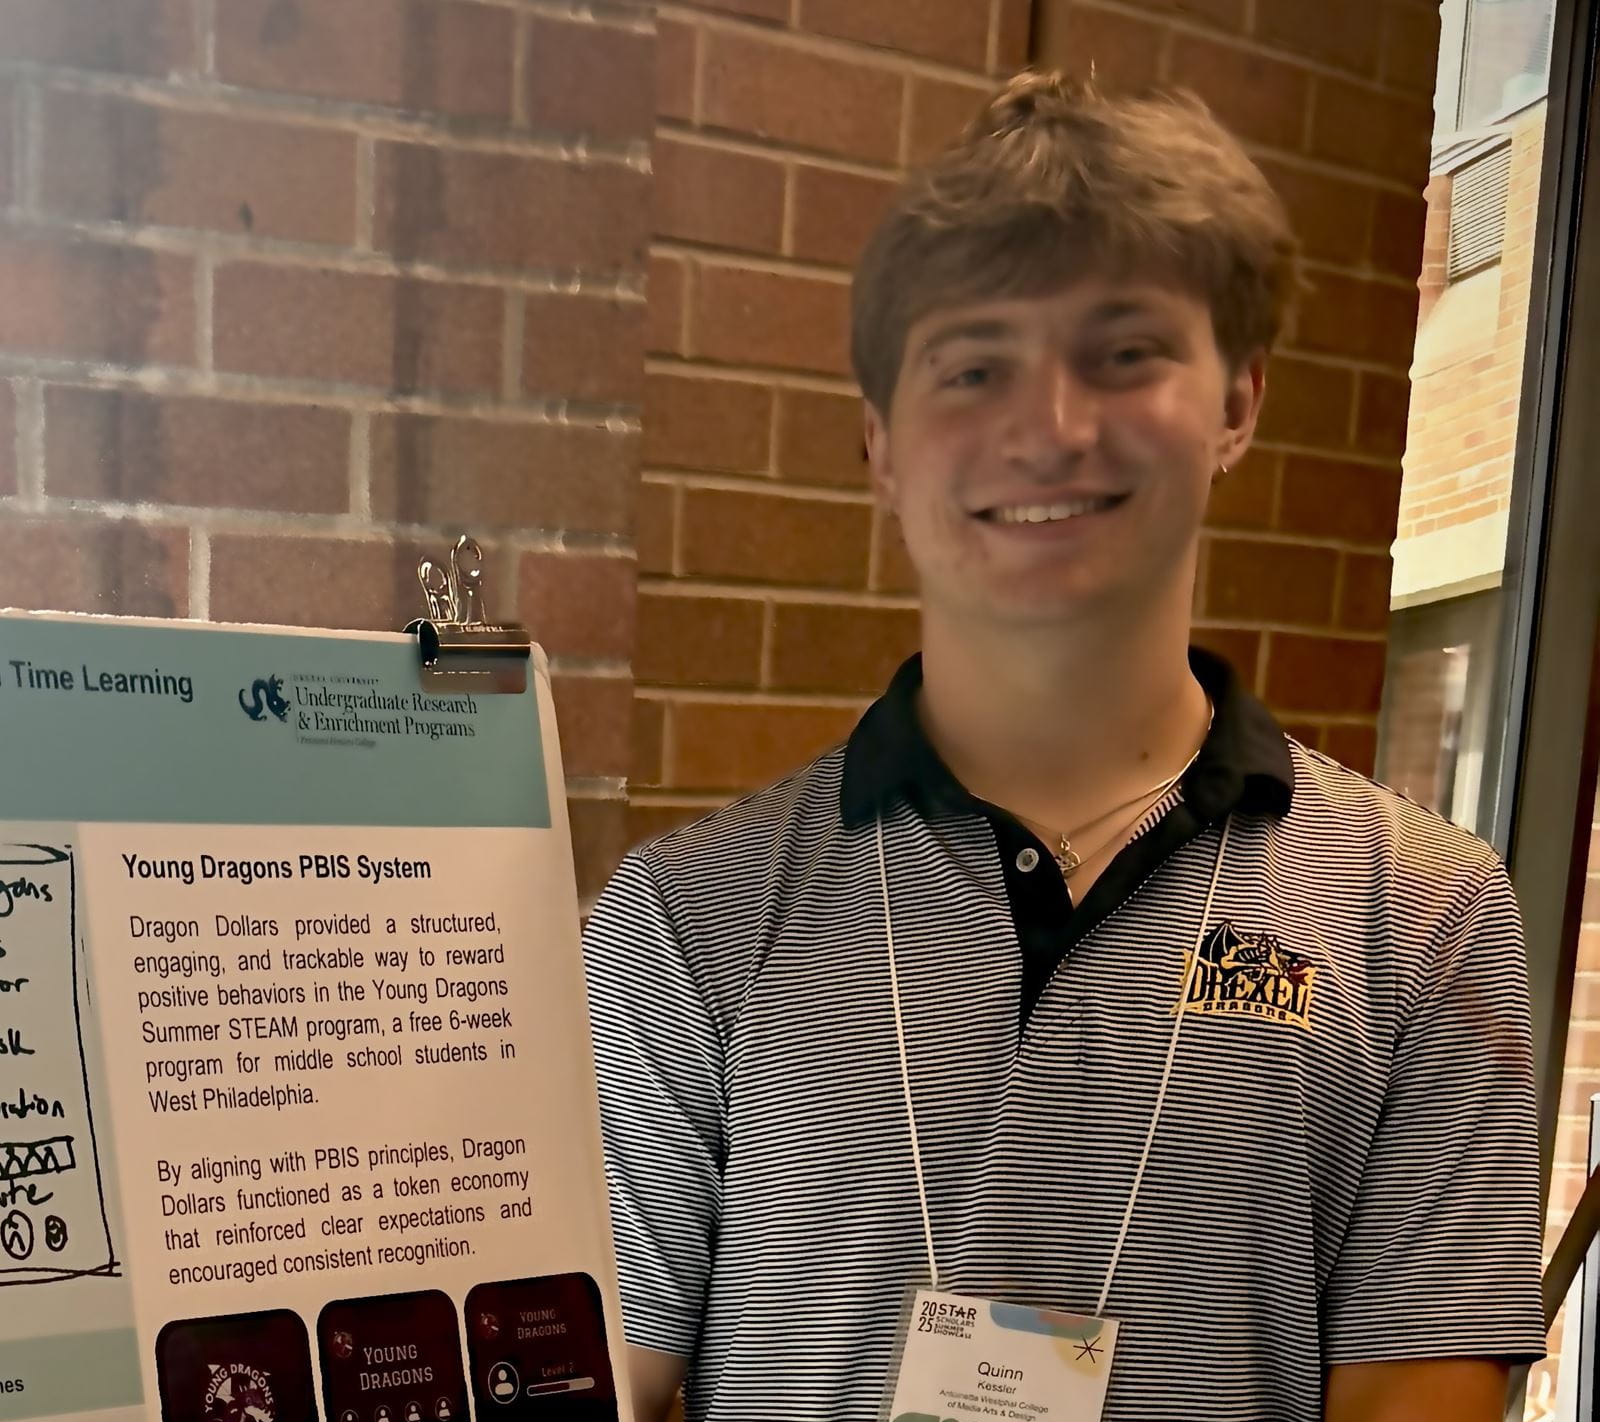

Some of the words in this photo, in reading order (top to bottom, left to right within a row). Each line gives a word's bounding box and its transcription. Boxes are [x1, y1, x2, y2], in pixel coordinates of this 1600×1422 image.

[9, 660, 74, 690] Time
[82, 664, 193, 703] Learning
[295, 686, 409, 715] Undergraduate
[412, 693, 478, 715] Research
[299, 711, 310, 730] &
[314, 712, 401, 734] Enrichment
[405, 716, 475, 740] Programs
[122, 854, 194, 885] Young
[201, 855, 292, 885] Dragons
[299, 855, 350, 878] PBIS
[357, 855, 431, 884] System
[978, 1361, 1024, 1381] Quinn
[205, 1368, 227, 1413] YOUNG
[230, 1364, 274, 1405] DRAGONS
